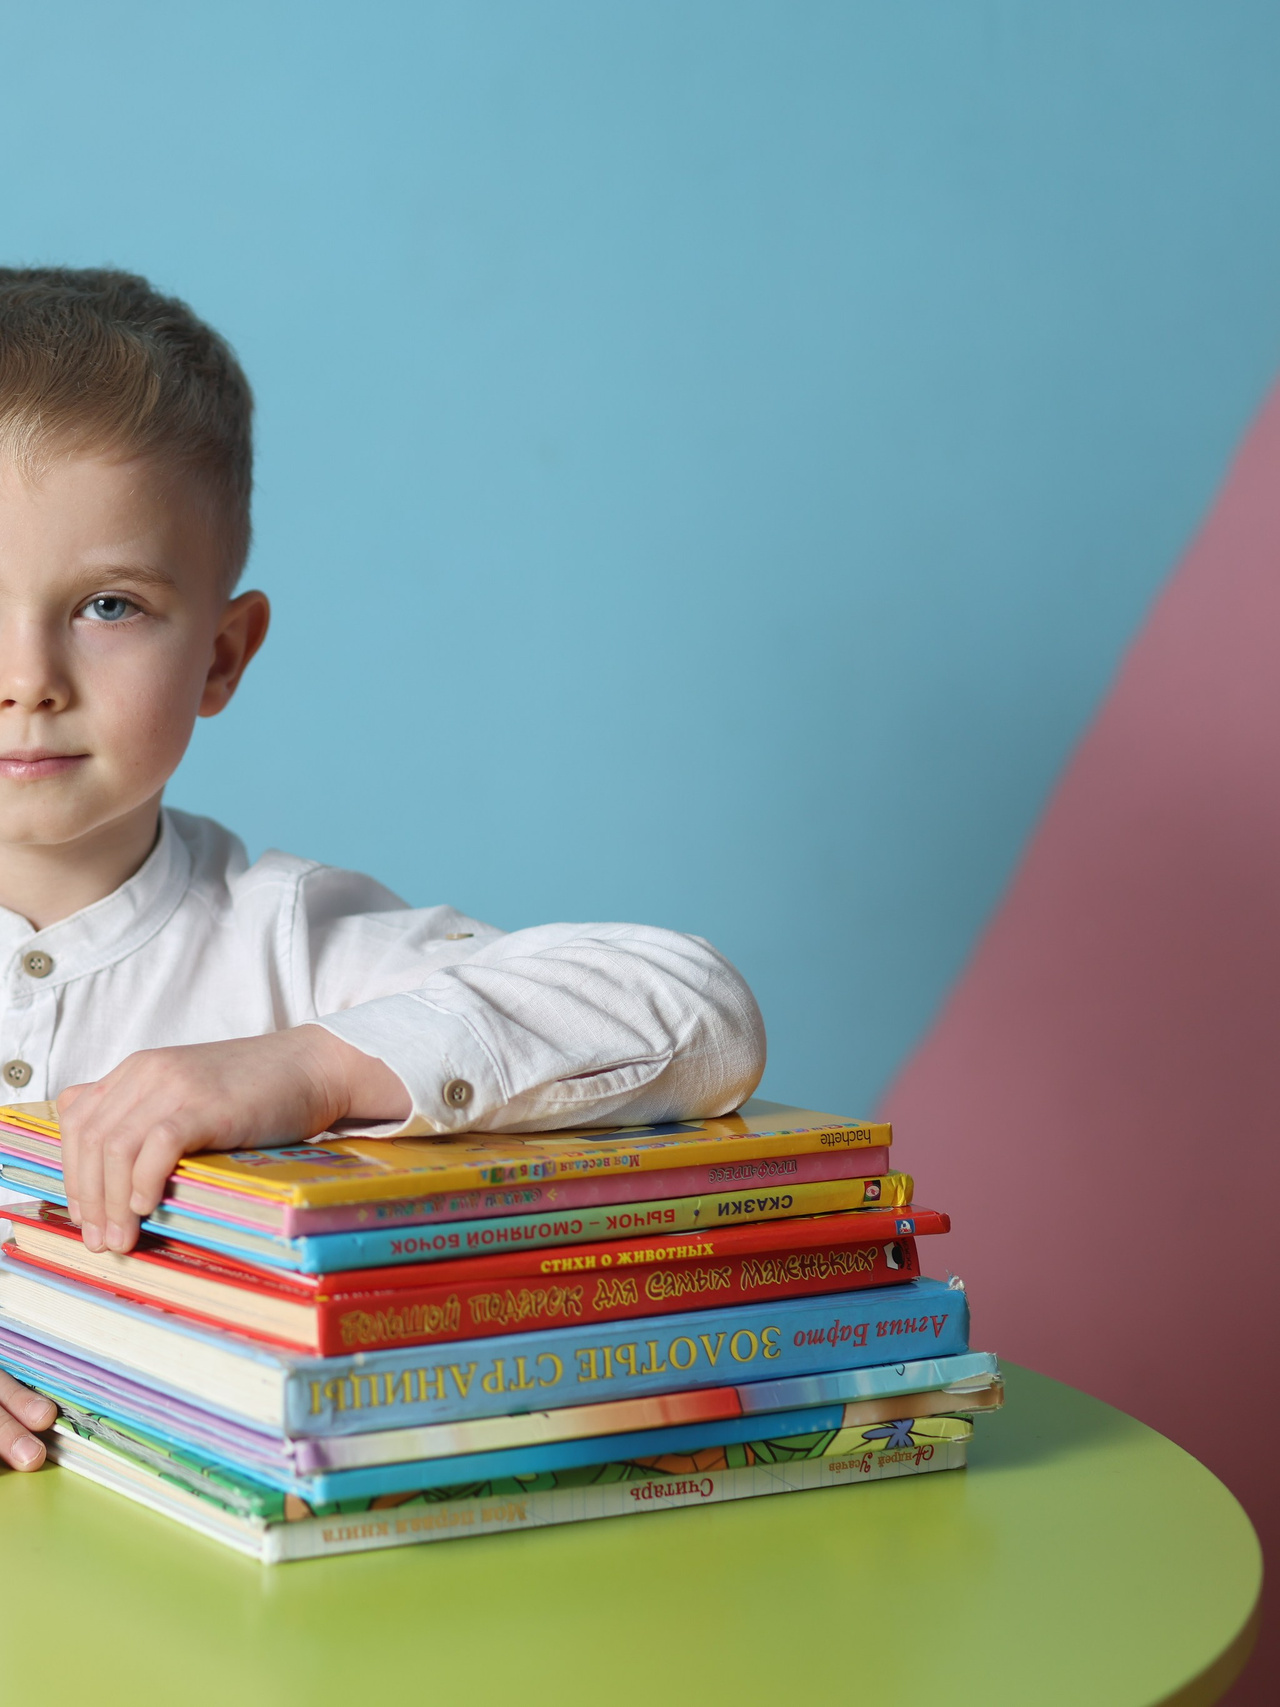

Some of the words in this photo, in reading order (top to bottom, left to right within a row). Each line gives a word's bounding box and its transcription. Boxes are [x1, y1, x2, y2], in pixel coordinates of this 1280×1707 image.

[821, 1130, 872, 1146] hachette
[479, 1161, 556, 1184] АЗБУКА
[559, 1157, 611, 1174] весёлая
[619, 1154, 640, 1168] Моя
[708, 1159, 797, 1184] ПРОФ-ПРЕСС
[717, 1194, 793, 1217] СКАЗКИ
[606, 1208, 676, 1230] БЫЧОК
[391, 1233, 460, 1255] БОЧОК
[466, 1219, 583, 1249] СМОЛЯНОЙ
[540, 1255, 596, 1274] СТИХИ
[602, 1253, 613, 1267] О
[617, 1242, 715, 1266] ЖИВОТНЫХ
[469, 1285, 583, 1325] ПОДАРОК
[592, 1278, 638, 1312] ДЛЯ
[793, 1319, 870, 1348] Барто
[875, 1313, 949, 1339] Агния
[575, 1326, 782, 1383] ЗОЛОТЫЕ
[309, 1351, 565, 1416] СТРАНИЦЫ
[828, 1452, 873, 1474] Усачёв
[877, 1444, 935, 1468] Андрей
[630, 1477, 714, 1501] Считарь
[396, 1507, 475, 1535] первая
[481, 1502, 528, 1523] Моя
[321, 1522, 389, 1543] книга
